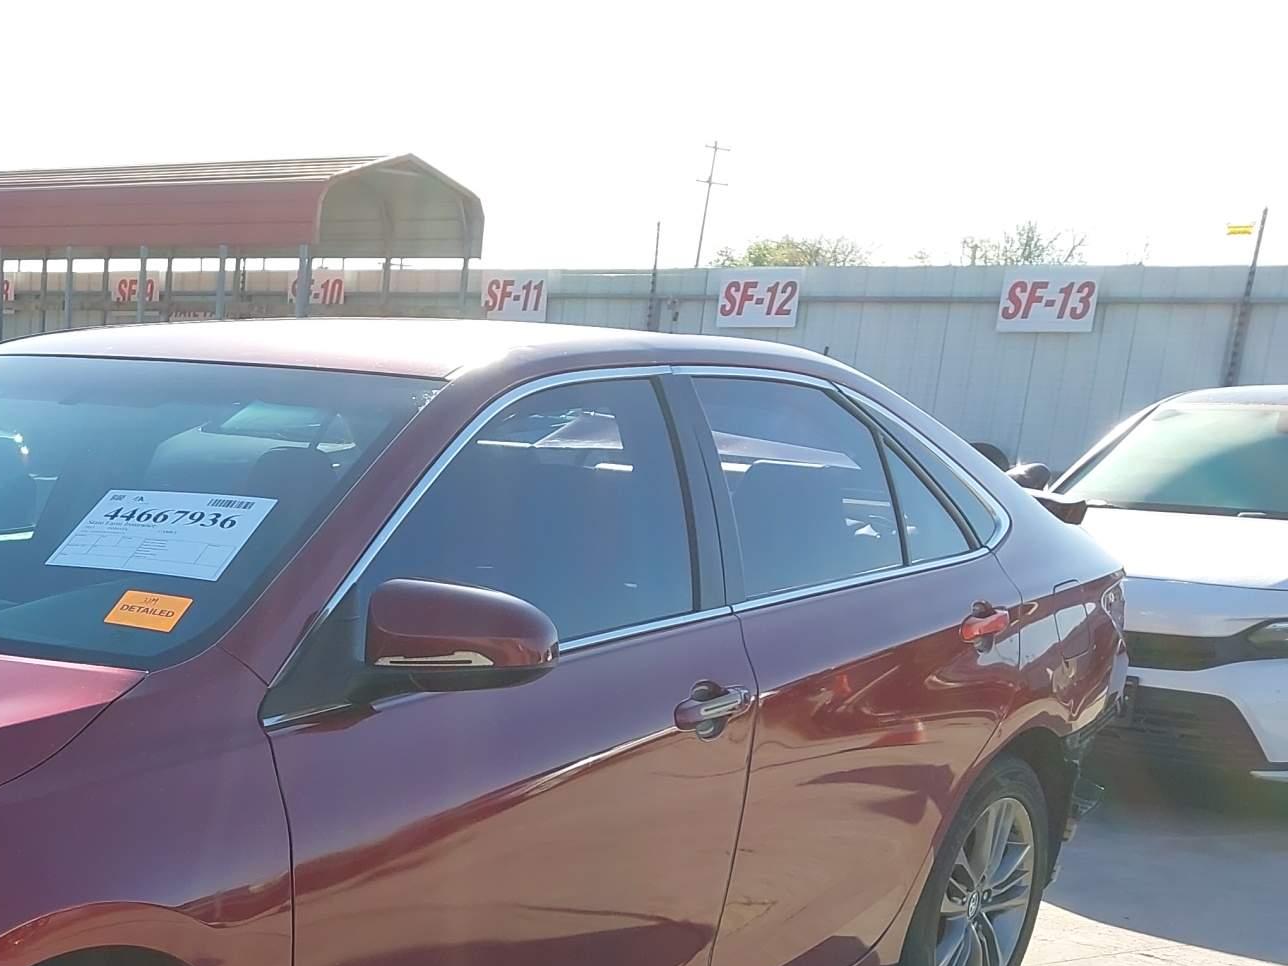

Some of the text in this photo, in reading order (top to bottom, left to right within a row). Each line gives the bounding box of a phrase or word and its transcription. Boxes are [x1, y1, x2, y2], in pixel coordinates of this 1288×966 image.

[484, 279, 544, 312] SF-11
[720, 280, 798, 317] SF-12
[1001, 280, 1097, 320] SF-13
[104, 506, 240, 529] 44667936
[120, 604, 175, 617] DETAILED
